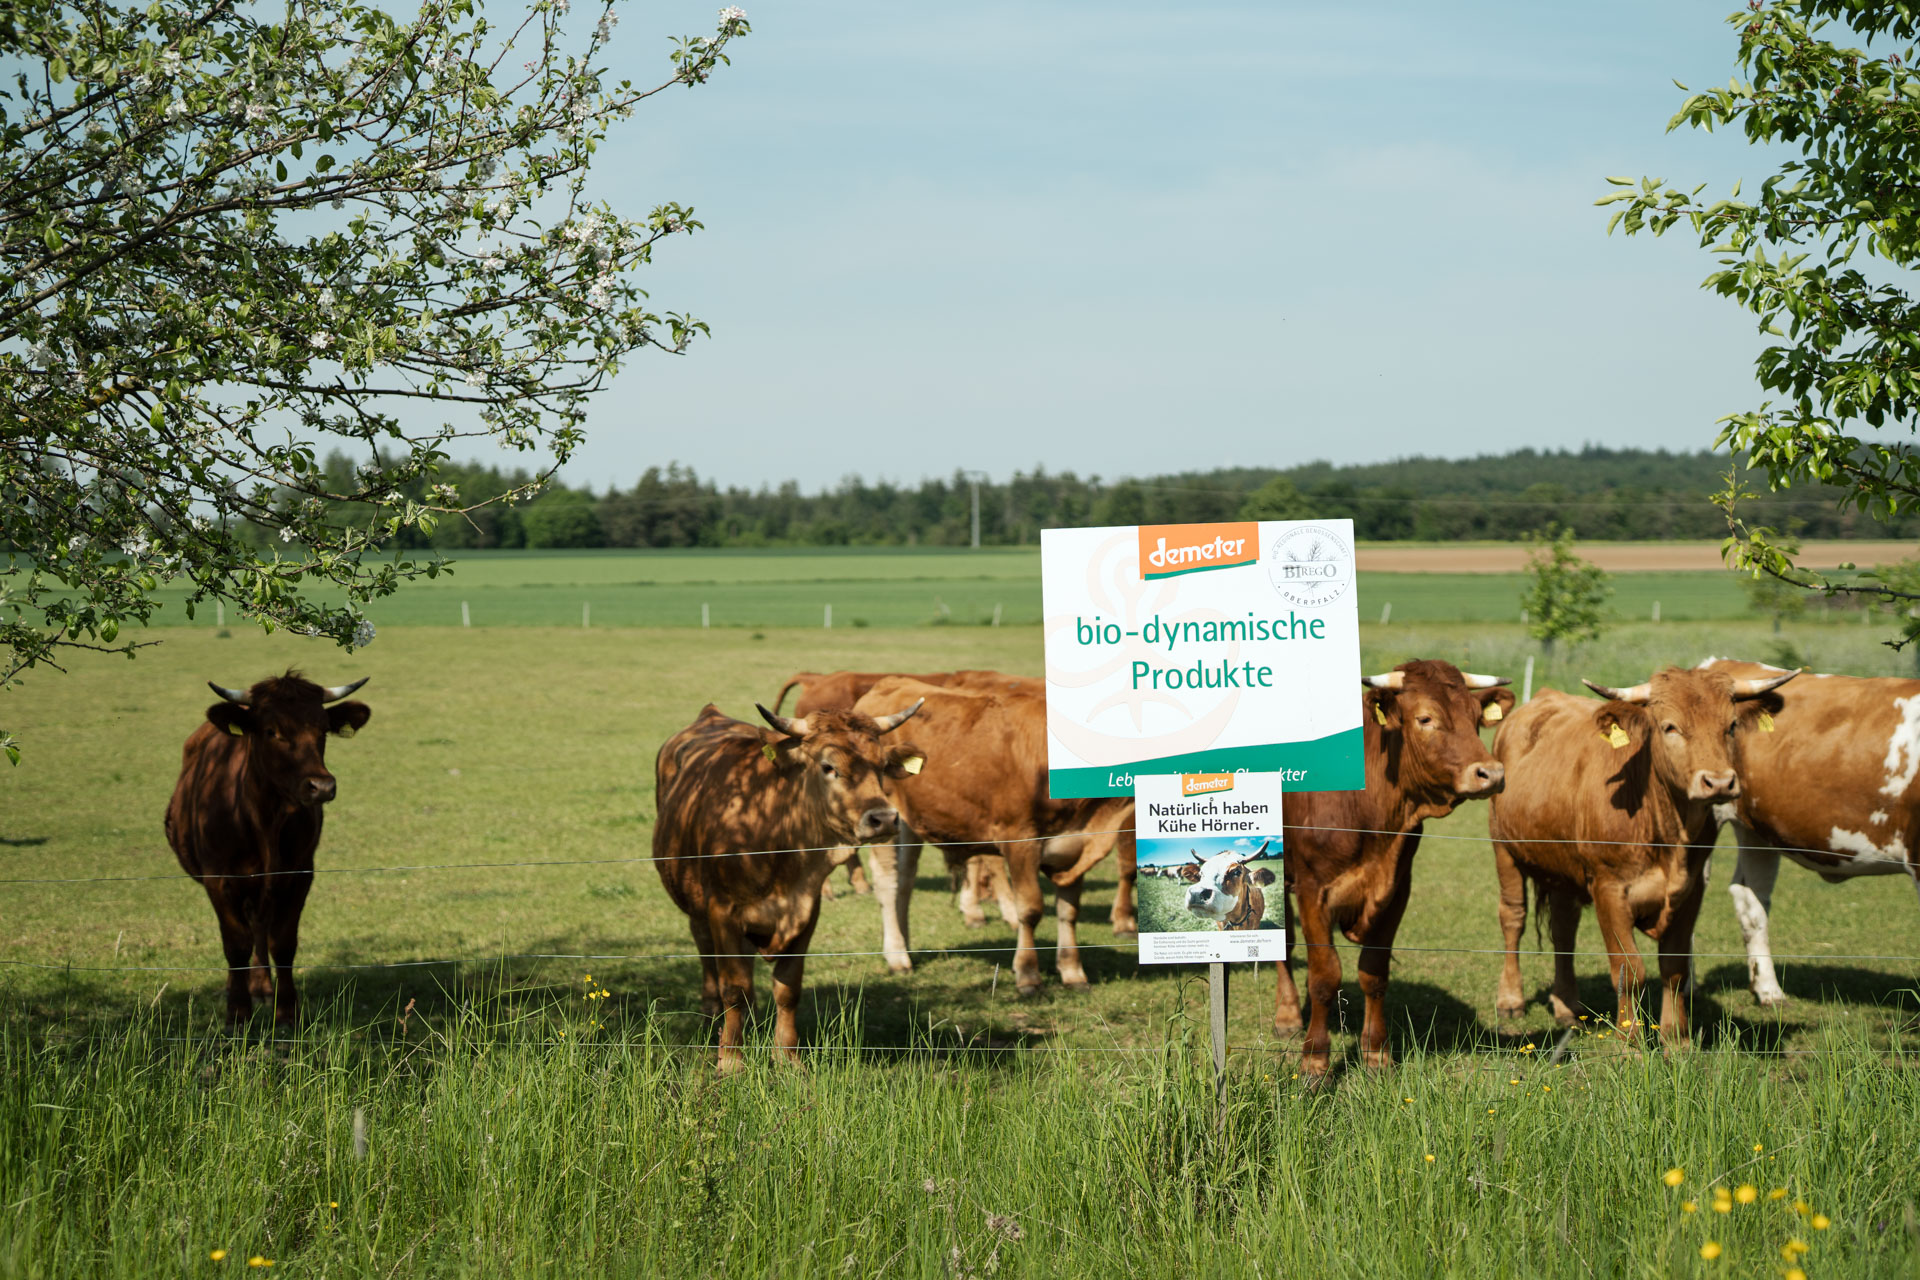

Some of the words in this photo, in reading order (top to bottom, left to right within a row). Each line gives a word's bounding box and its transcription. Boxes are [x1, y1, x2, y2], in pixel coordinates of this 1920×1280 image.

[1148, 536, 1246, 567] demeter
[1283, 589, 1340, 606] OBERPFALZ
[1076, 611, 1326, 651] bio-dynamische
[1132, 659, 1273, 690] Produkte
[1185, 777, 1229, 792] demeter
[1149, 800, 1218, 817] Natürlich
[1222, 800, 1269, 815] haben
[1158, 819, 1197, 833] Kühe
[1201, 818, 1260, 832] Hörner.
